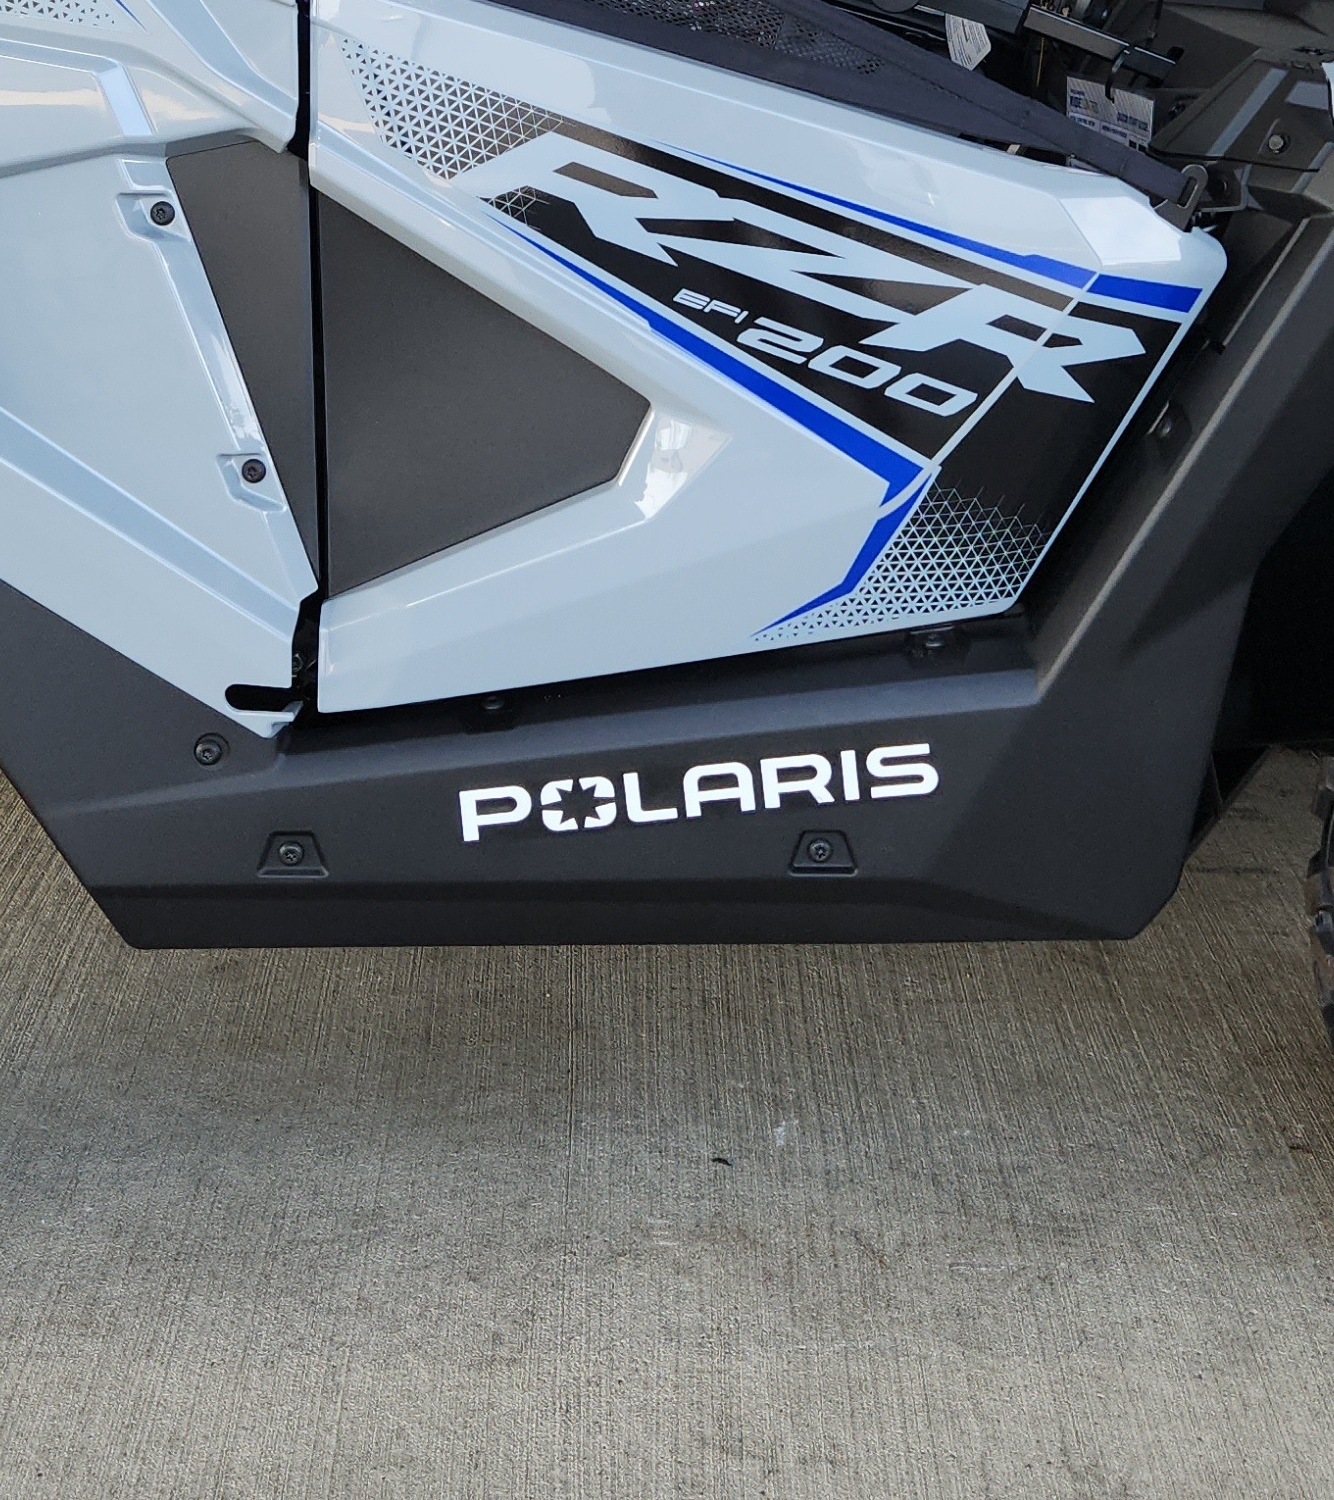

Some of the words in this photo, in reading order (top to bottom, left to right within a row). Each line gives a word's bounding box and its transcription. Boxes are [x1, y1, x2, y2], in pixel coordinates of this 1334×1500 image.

[673, 287, 749, 324] EFI
[737, 316, 979, 417] 200
[459, 743, 940, 842] POLARIS
